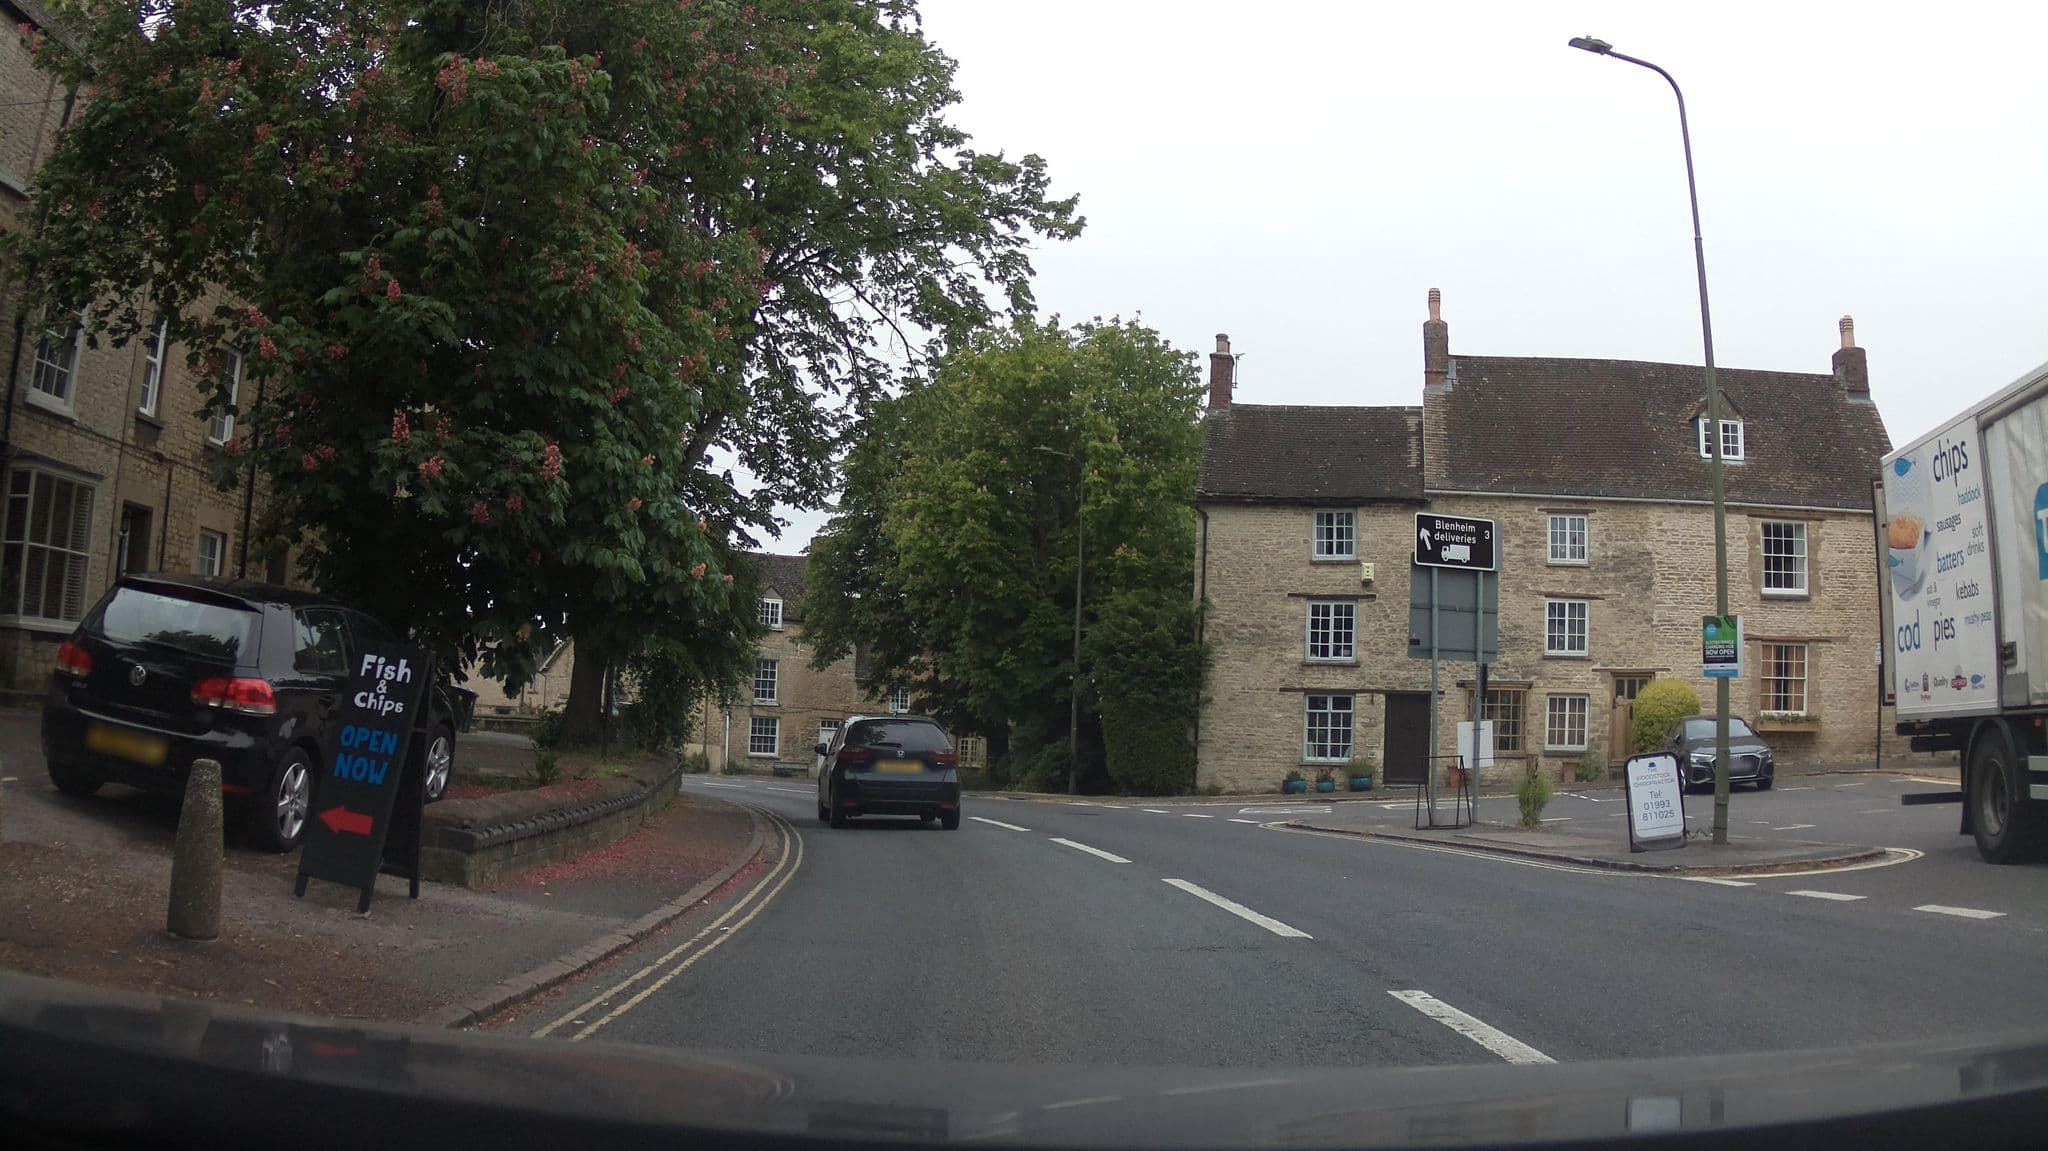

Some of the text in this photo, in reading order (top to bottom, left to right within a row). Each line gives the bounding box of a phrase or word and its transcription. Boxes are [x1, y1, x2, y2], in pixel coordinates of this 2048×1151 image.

[1933, 438, 1969, 488] chips
[1958, 484, 1982, 505] haddock
[1435, 520, 1476, 532] Blenheim
[1936, 513, 1962, 532] sausages
[1971, 521, 1983, 538] soft
[1434, 531, 1477, 544] deliveries
[1484, 530, 1490, 540] 3
[1966, 540, 1985, 556] drinks
[1936, 550, 1964, 574] batters
[1955, 578, 1979, 600] kebabs
[1897, 608, 1921, 653] cod
[1933, 611, 1956, 652] pies
[360, 654, 411, 684] Fish
[376, 679, 387, 694] &
[354, 691, 404, 716] Chips
[339, 725, 398, 755] OPEN
[333, 753, 389, 785] NOW
[1642, 810, 1675, 821] 811025
[1643, 800, 1671, 811] 01993
